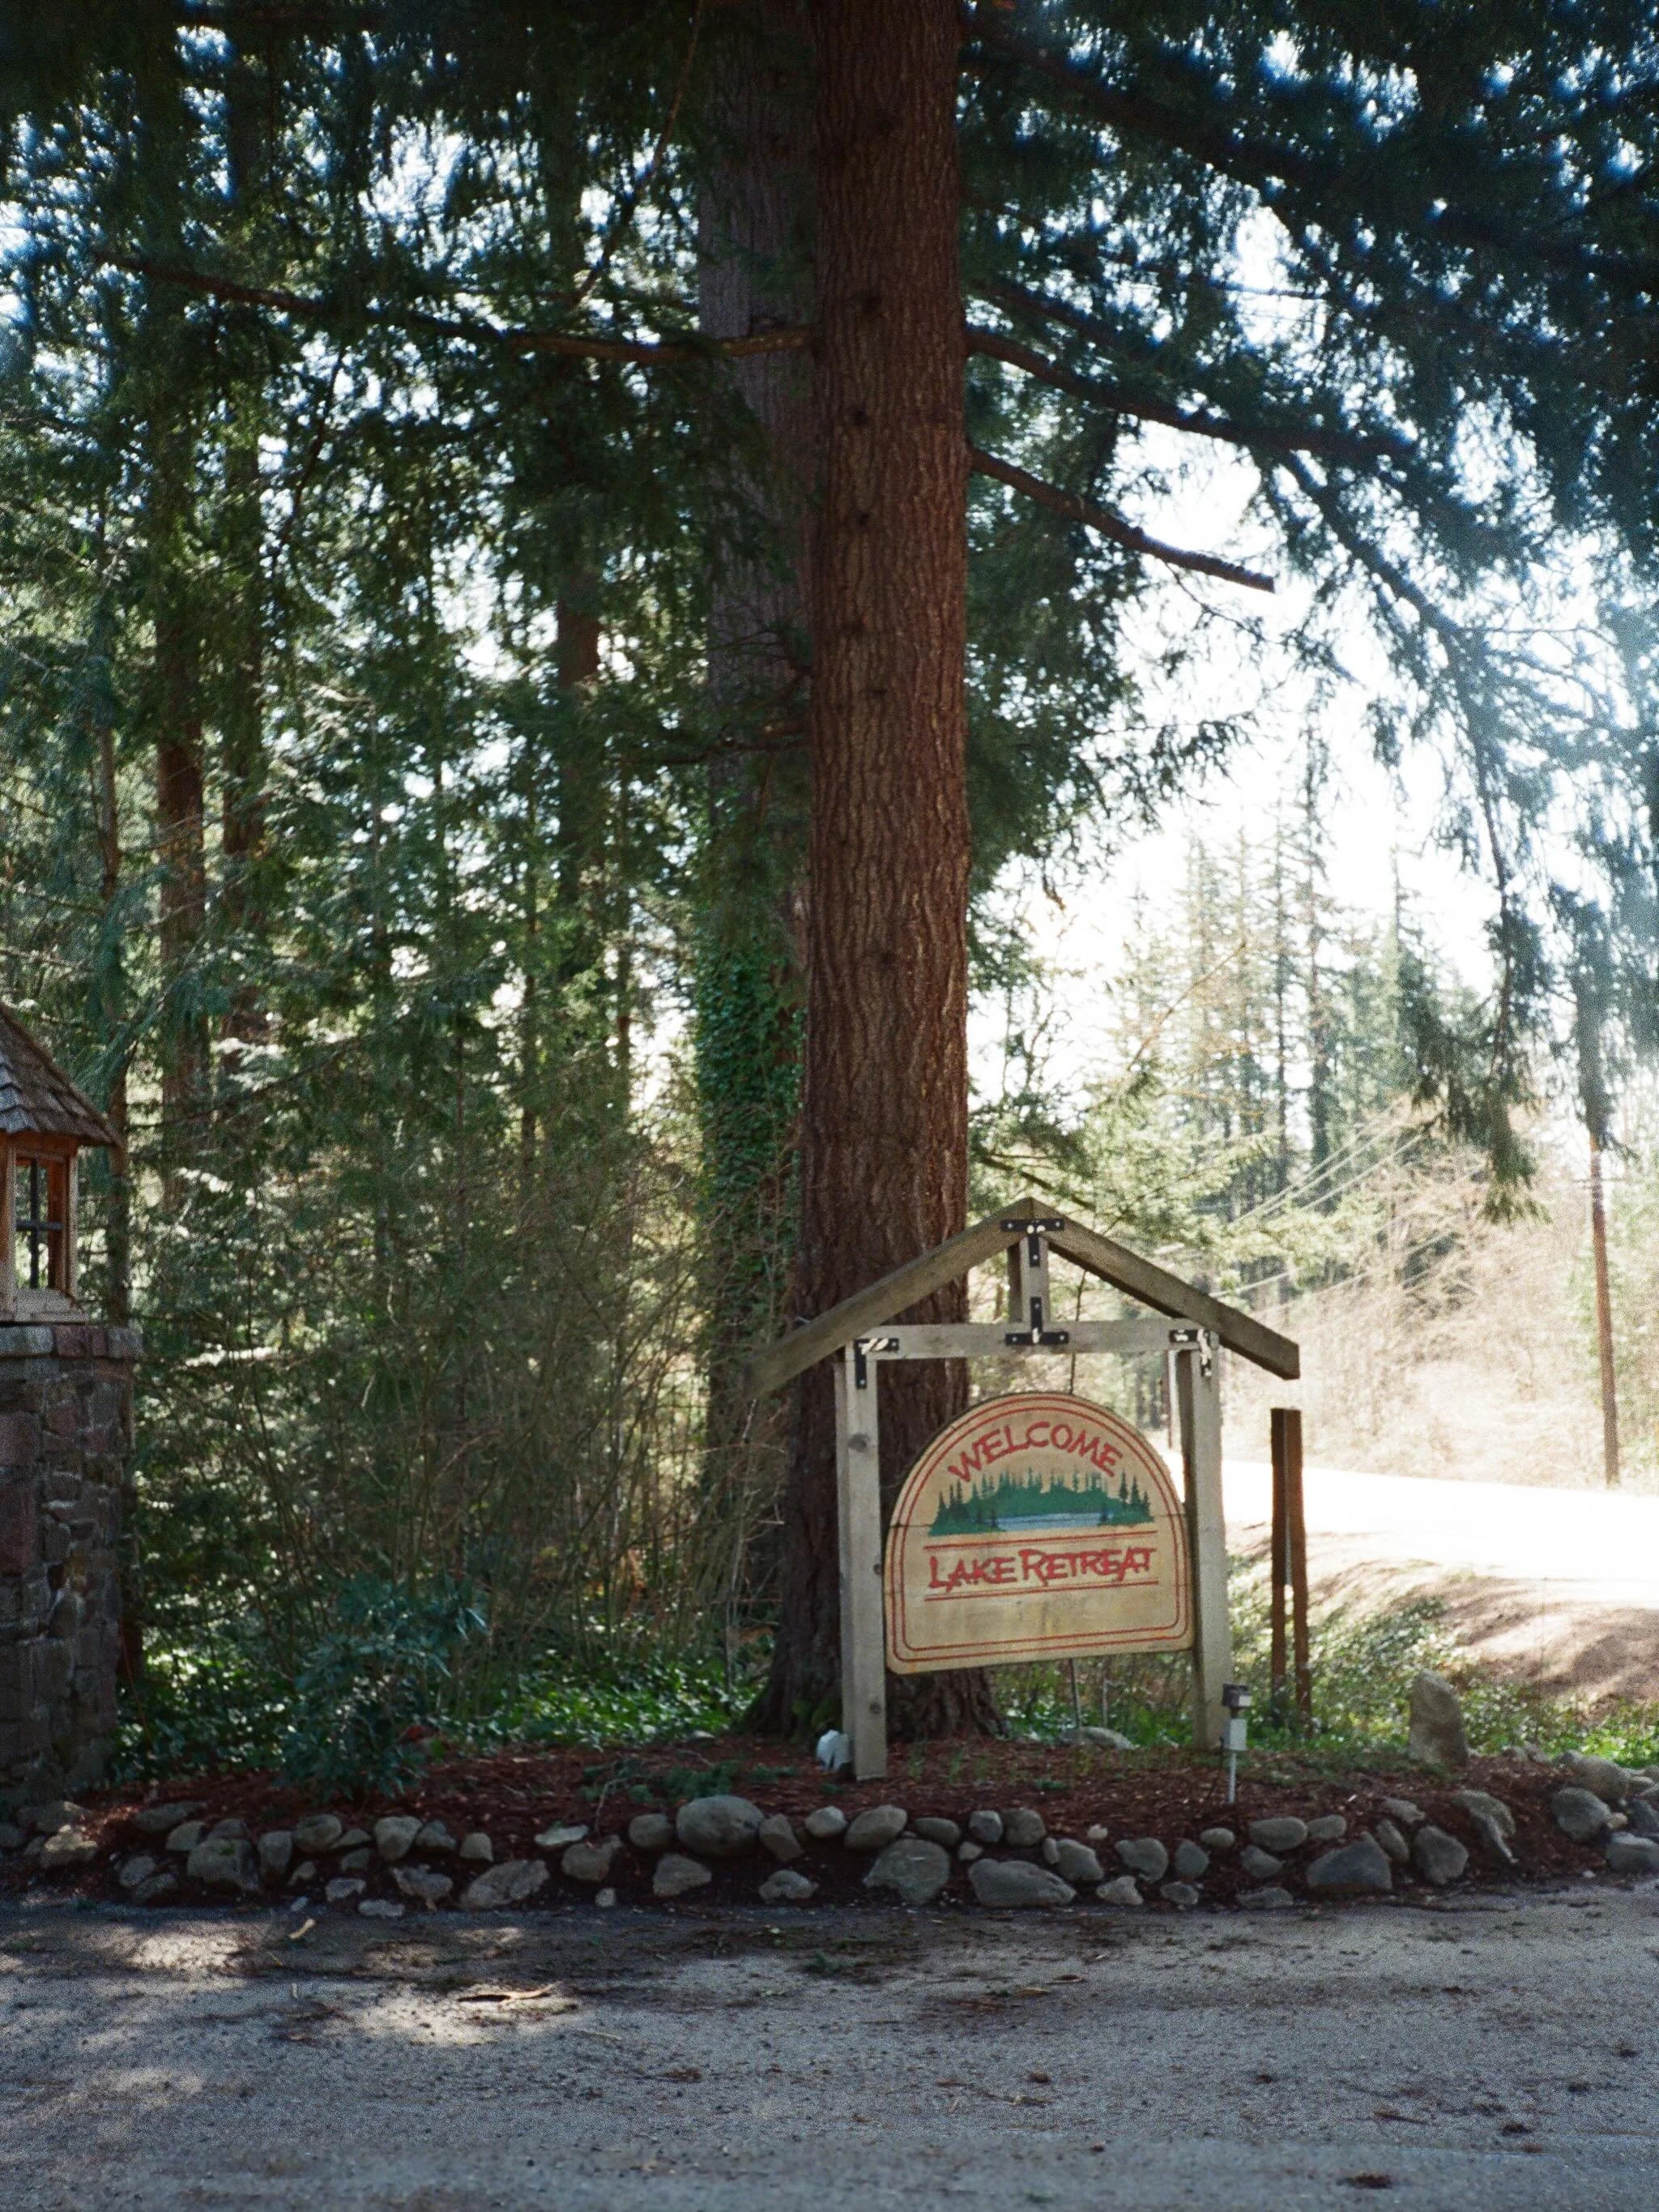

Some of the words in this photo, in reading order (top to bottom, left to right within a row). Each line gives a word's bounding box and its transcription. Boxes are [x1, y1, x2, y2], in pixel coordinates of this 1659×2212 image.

[947, 1420, 1123, 1483] WELCOME
[928, 1555, 1017, 1592] LAKE
[1018, 1547, 1157, 1586] RETREAT
